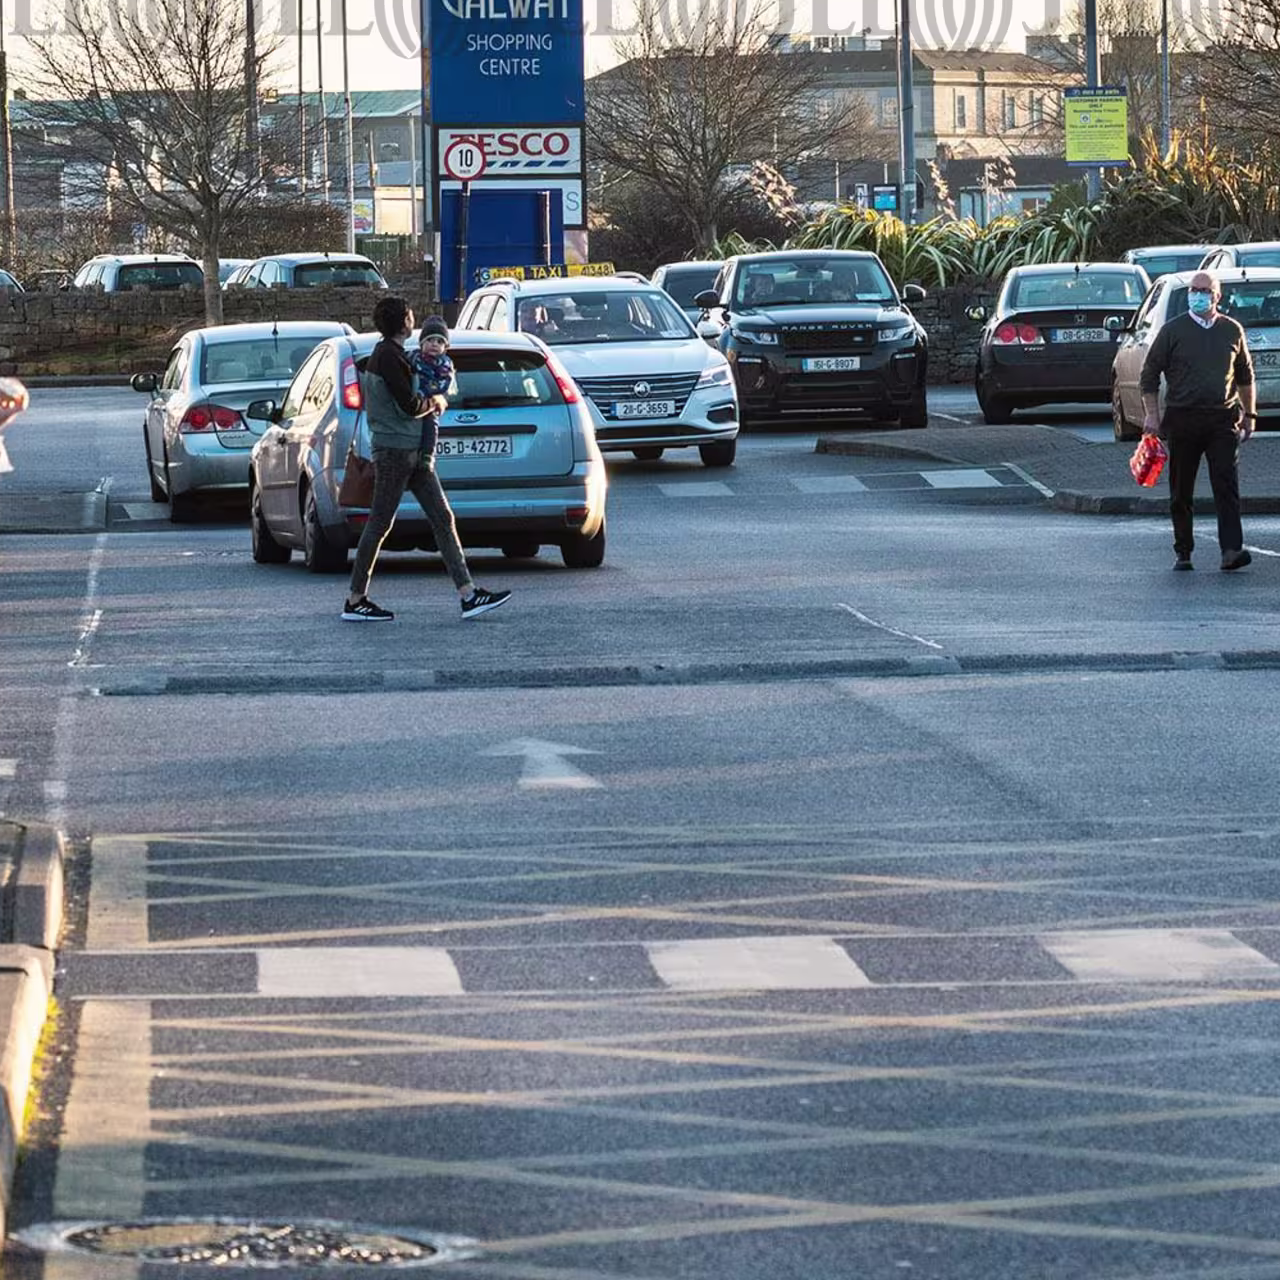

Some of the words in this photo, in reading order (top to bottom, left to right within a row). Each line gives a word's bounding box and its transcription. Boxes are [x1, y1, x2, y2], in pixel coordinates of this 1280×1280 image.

[467, 33, 553, 53] SHOPPING
[478, 58, 541, 76] CENTRE
[459, 149, 473, 168] 10
[531, 267, 562, 279] TAXI
[436, 439, 508, 455] 06-D-42772
